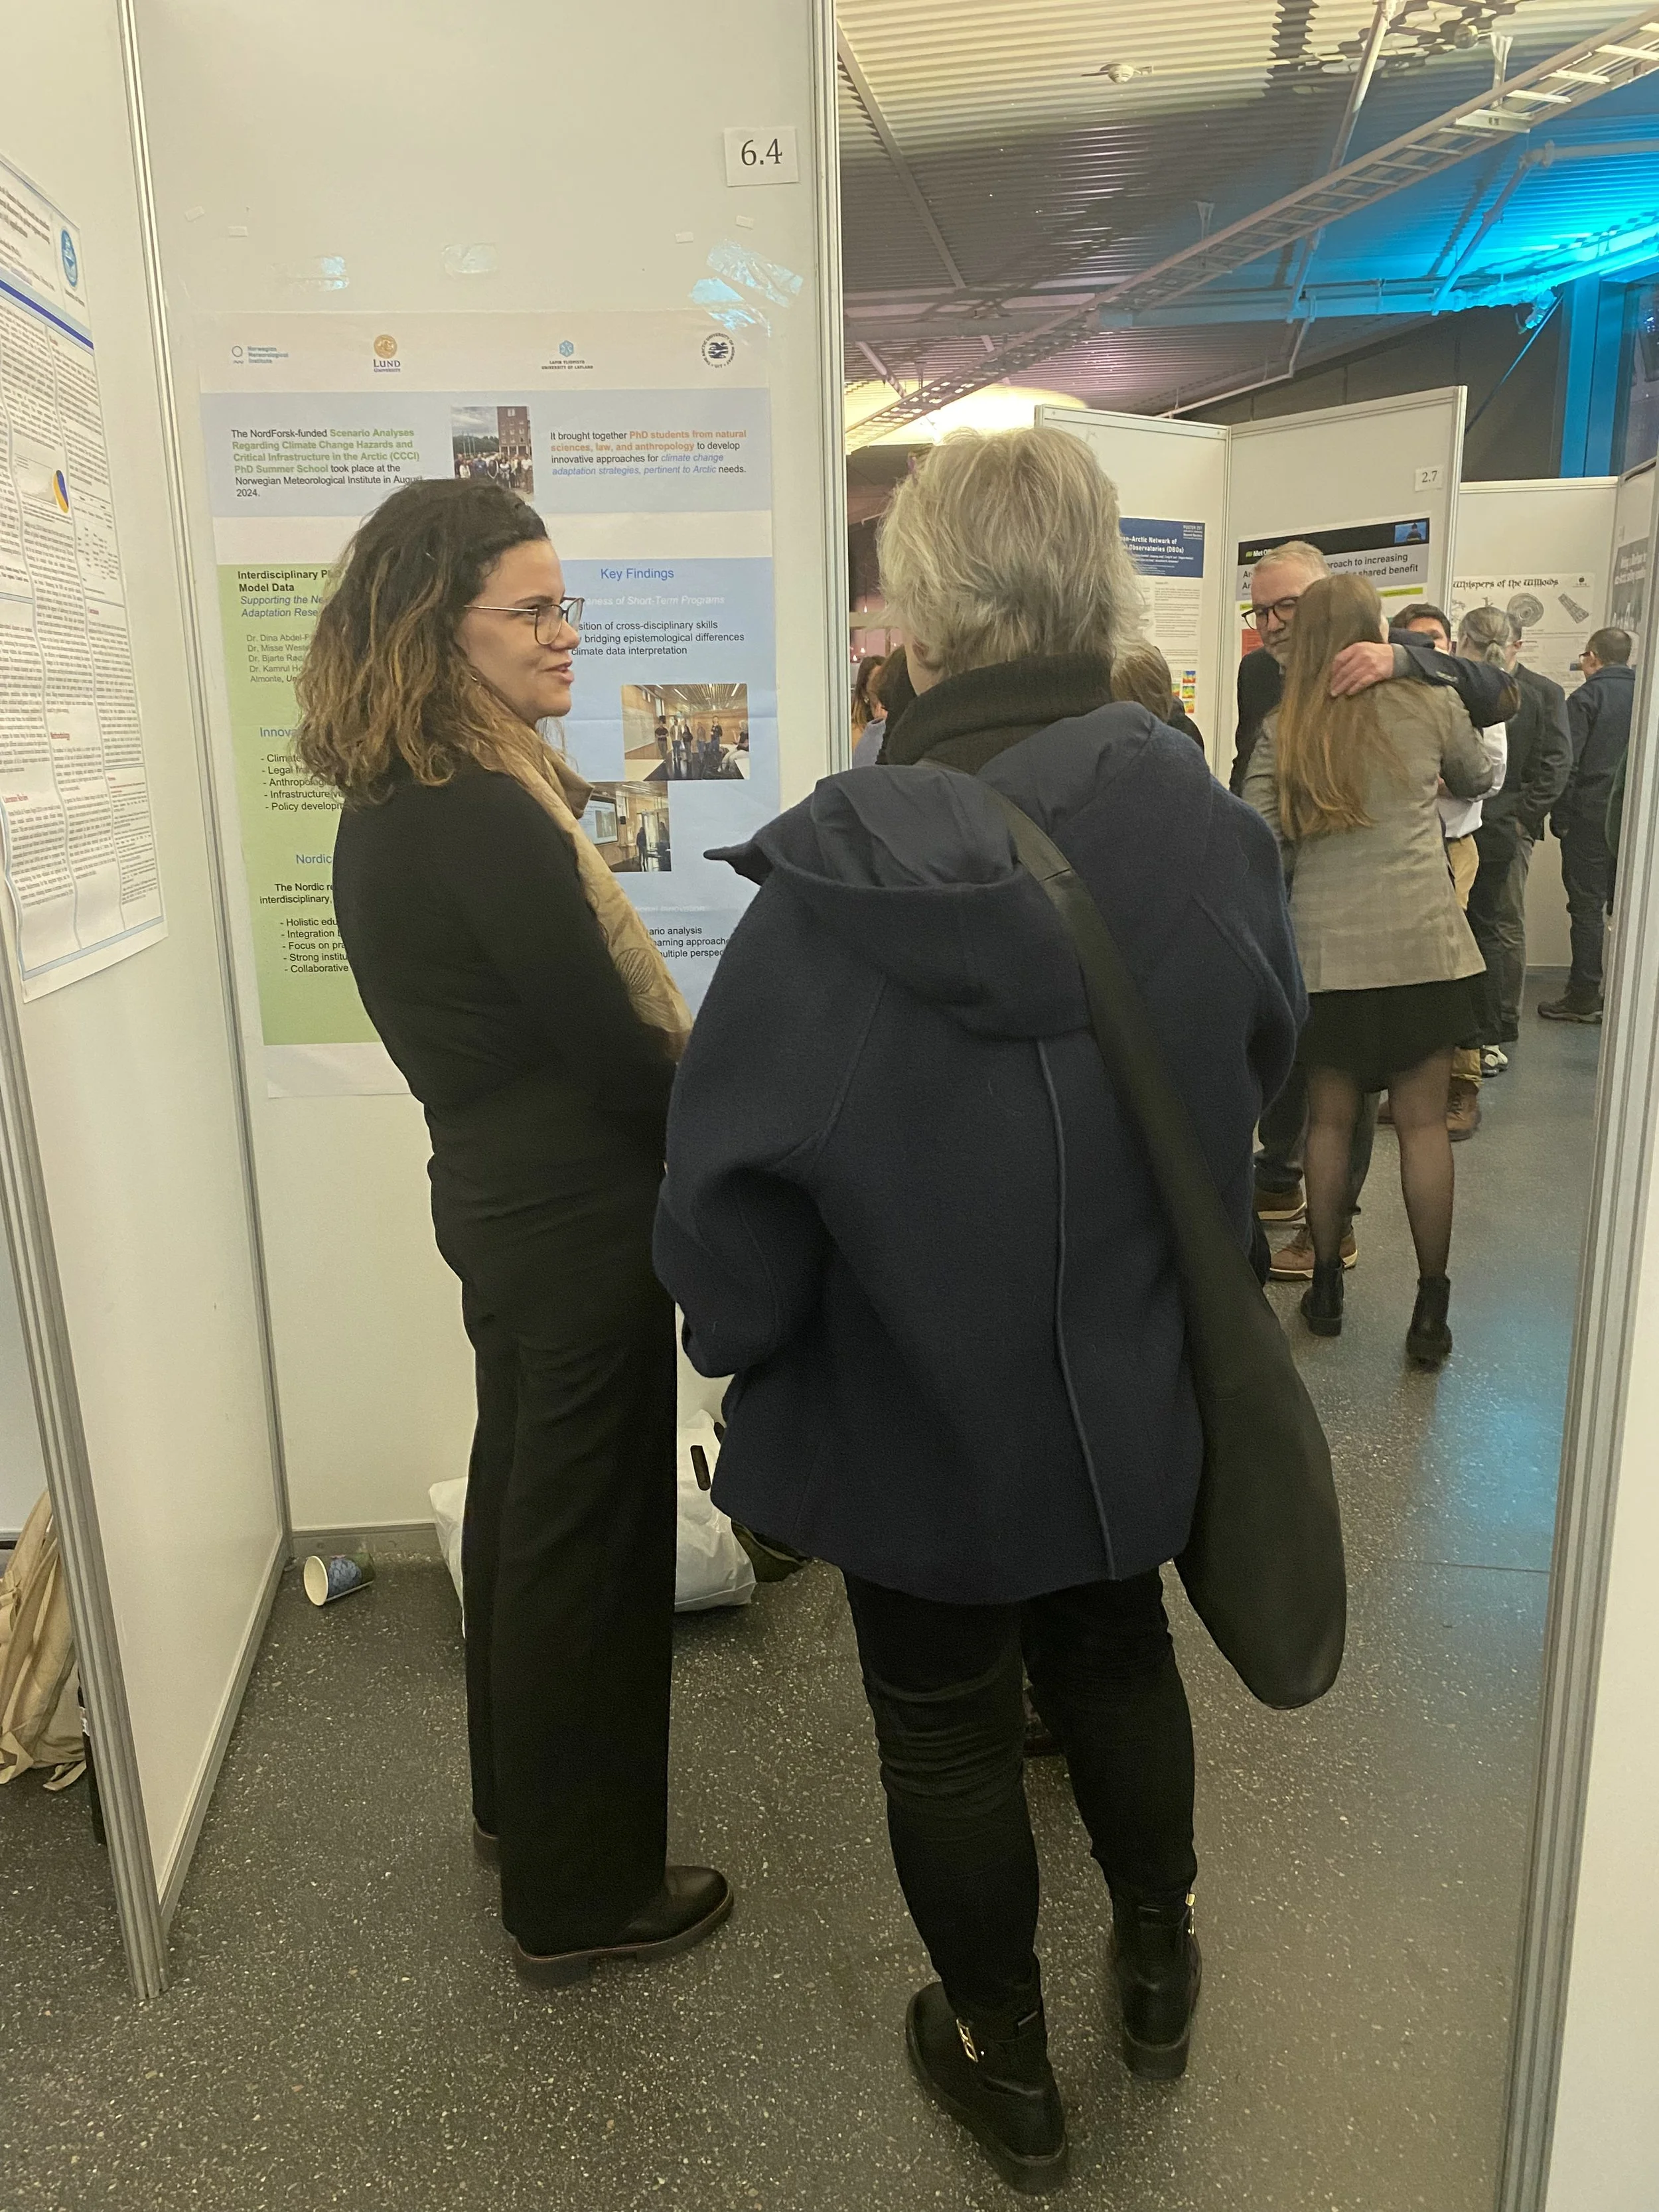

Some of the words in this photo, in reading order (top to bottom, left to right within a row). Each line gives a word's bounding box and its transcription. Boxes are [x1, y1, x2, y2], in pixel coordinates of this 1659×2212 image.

[741, 138, 782, 166] 6.4
[232, 429, 248, 439] The
[250, 429, 327, 438] NordForsk-funded
[330, 429, 370, 437] Scenario
[373, 429, 414, 438] Analyses
[558, 431, 590, 442] brought
[593, 431, 626, 441] together
[651, 430, 689, 439] students
[715, 429, 746, 438] natural
[233, 441, 279, 451] Regarding
[282, 441, 317, 449] Climate
[319, 440, 354, 451] Change
[356, 440, 394, 449] Hazards
[396, 439, 413, 449] and
[551, 443, 593, 453] sciences,
[596, 443, 613, 452] law,
[635, 442, 694, 453] anthropology
[707, 441, 740, 451] develop
[234, 453, 265, 461] Critical
[268, 452, 330, 461] Infrastructure
[332, 452, 340, 461] in
[343, 452, 358, 461] the
[360, 451, 388, 461] Arctic
[390, 451, 419, 462] (CCCI)
[551, 455, 593, 463] innovative
[596, 454, 645, 465] approaches
[648, 453, 658, 462] for
[661, 453, 691, 462] climate
[693, 453, 723, 463] change
[235, 465, 253, 474] PhD
[256, 465, 294, 473] Summer
[297, 464, 328, 473] School
[331, 464, 348, 473] took
[350, 464, 374, 475] place
[552, 466, 596, 476] adaptation
[599, 466, 640, 476] strategies,
[644, 465, 680, 476] pertinent
[236, 477, 281, 487] Norwegian
[284, 476, 345, 486] Meteorological
[348, 476, 381, 484] Institute
[1421, 471, 1438, 483] 2.7
[237, 488, 260, 497] 2024.
[1364, 553, 1408, 565] increasing
[238, 571, 318, 581] Interdisciplinary
[601, 569, 622, 581] Key
[626, 568, 674, 580] Findings
[1358, 567, 1386, 577] shared
[1389, 564, 1418, 574] benefit
[1453, 581, 1494, 590] Whispers
[1496, 579, 1506, 588] of
[1508, 579, 1522, 589] the
[1523, 578, 1559, 587] Willows
[240, 596, 291, 605] Supporting
[615, 597, 625, 606] of
[627, 596, 679, 606] Short-Term
[681, 595, 725, 607] Programs
[242, 609, 291, 618] Adaptation
[579, 621, 602, 630] sition
[605, 621, 613, 630] of
[616, 621, 693, 632] cross-disciplinary
[585, 634, 620, 644] bridging
[623, 633, 693, 644] epistemological
[695, 633, 745, 642] differences
[607, 646, 626, 655] data
[628, 646, 687, 656] interpretation
[268, 767, 293, 776] Legal
[271, 802, 299, 812] Policy
[296, 854, 332, 863] Nordic
[286, 918, 319, 926] Holistic
[287, 930, 334, 939] Integration
[668, 926, 702, 936] analysis
[289, 942, 316, 950] Focus
[289, 954, 319, 962] Strong
[690, 950, 723, 958] perspec
[291, 964, 349, 973] Collaborative
